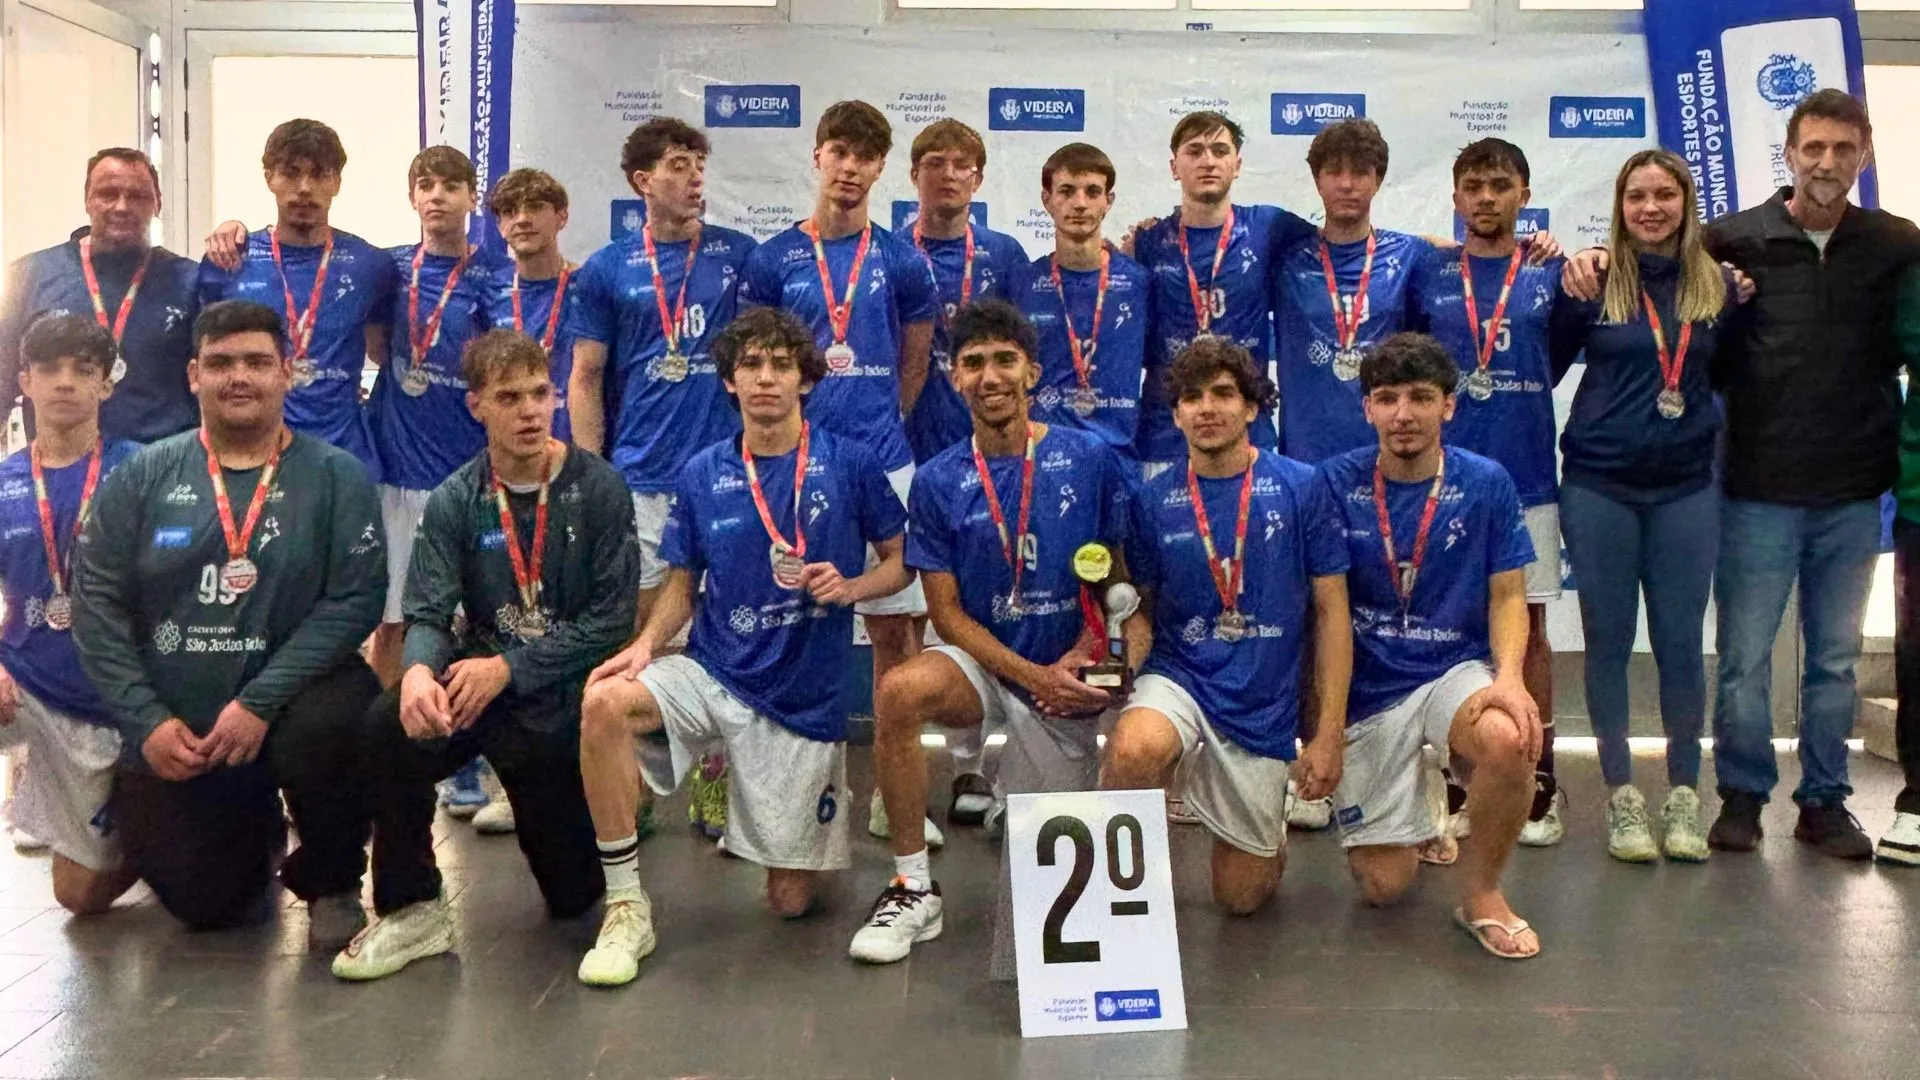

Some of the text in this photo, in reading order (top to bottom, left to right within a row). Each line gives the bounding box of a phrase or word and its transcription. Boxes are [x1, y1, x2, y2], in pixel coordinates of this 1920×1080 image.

[1023, 101, 1074, 114] VIDEIRA
[1305, 104, 1355, 118] VIDEIRA
[1583, 108, 1635, 121] VIDEIRA
[1677, 72, 1701, 162] ESPORTES
[1696, 48, 1729, 218] FUNDAÇÃO MUNICI
[817, 783, 837, 825] 6
